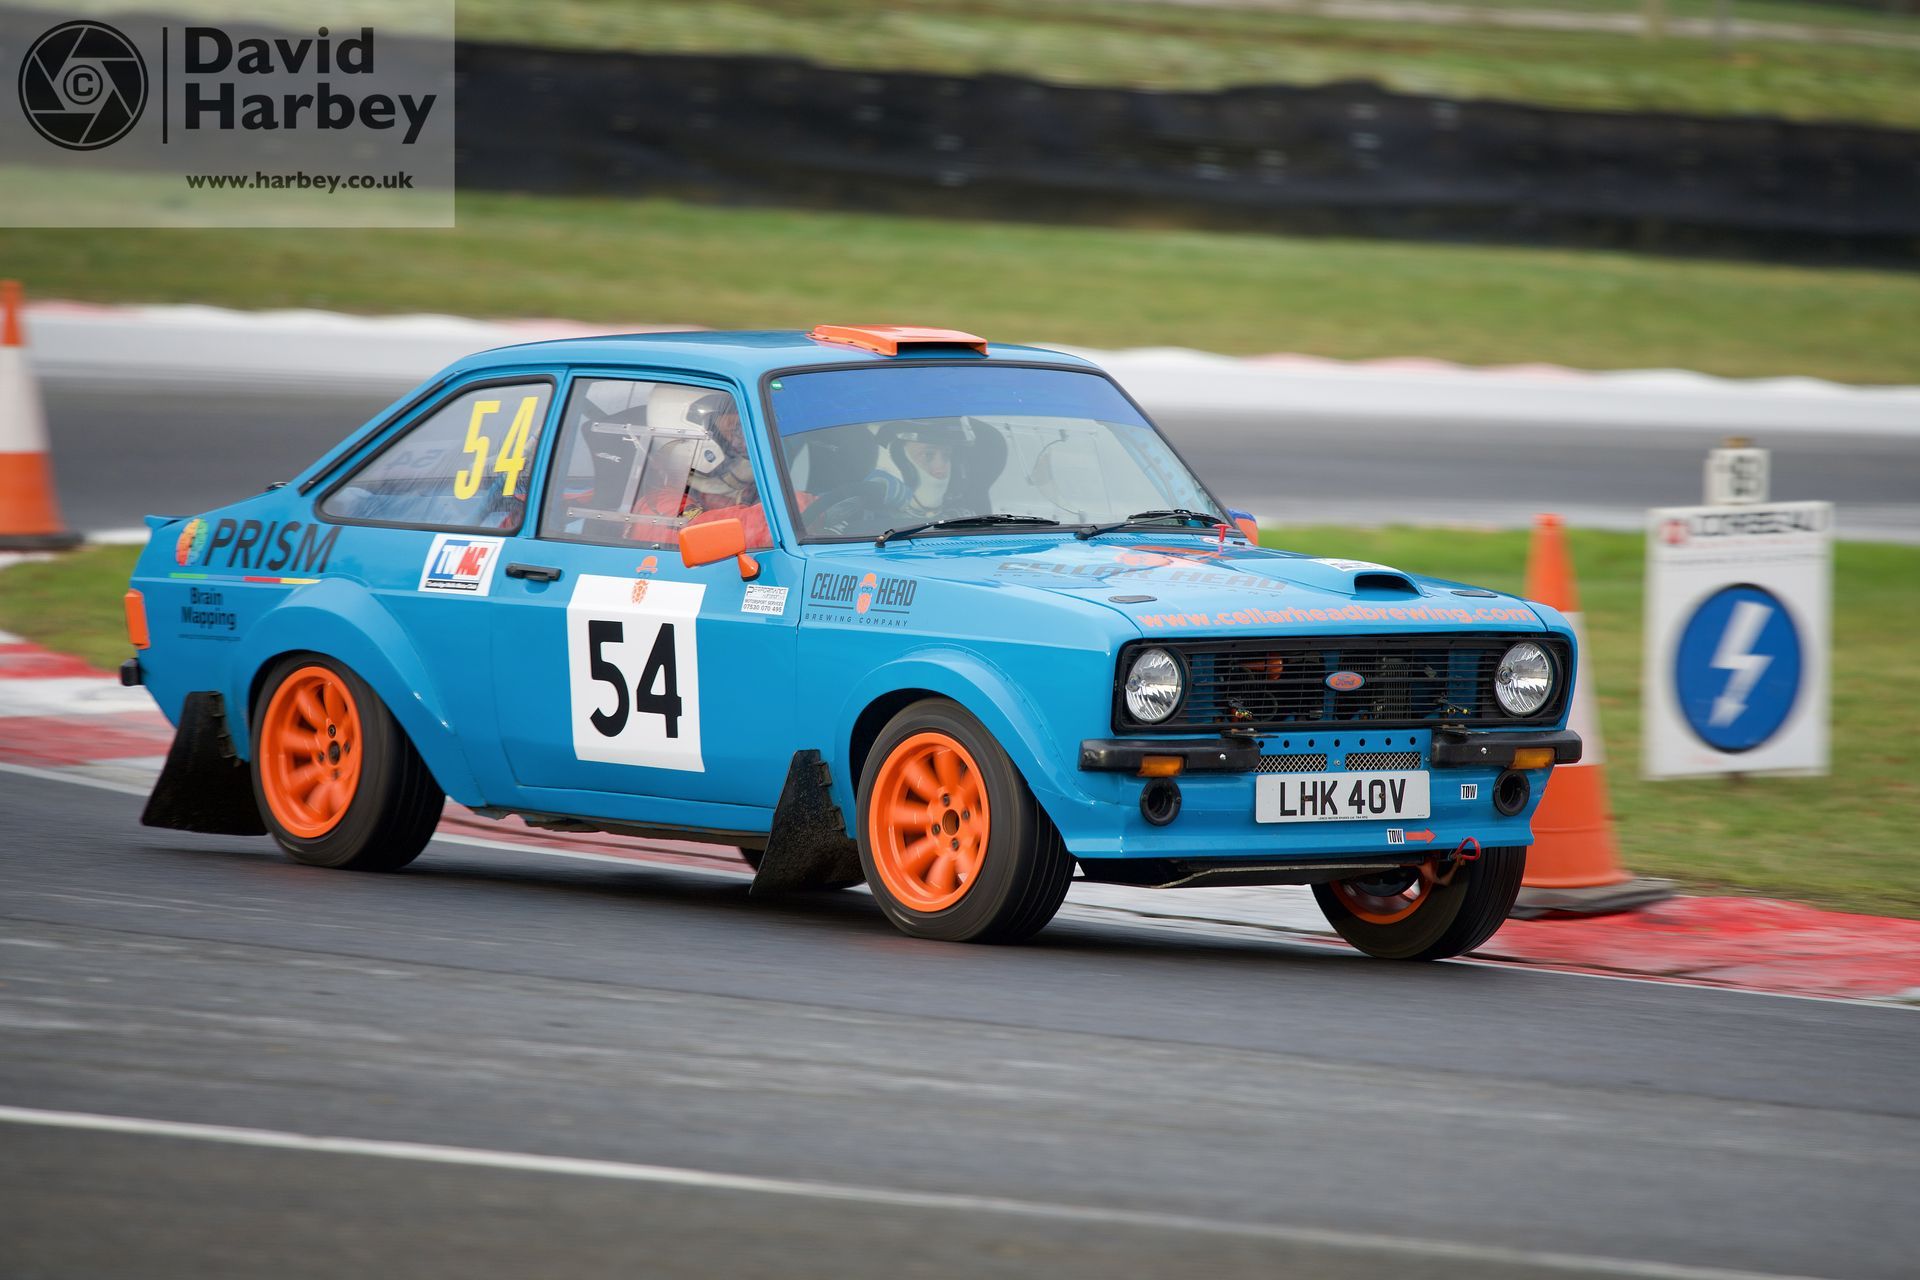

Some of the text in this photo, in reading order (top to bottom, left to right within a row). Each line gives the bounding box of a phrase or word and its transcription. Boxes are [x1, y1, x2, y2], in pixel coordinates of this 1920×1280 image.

[454, 397, 538, 500] 54
[202, 518, 343, 574] PRISM
[811, 573, 917, 606] CELLAR HEAD
[1168, 570, 1288, 590] HEAD
[190, 587, 223, 605] Brain
[181, 607, 237, 630] Mapping
[805, 613, 907, 626] BREWING COMPANY
[1136, 605, 1537, 627] www.cellarheadbrewing.com
[588, 620, 682, 739] 54
[1280, 779, 1406, 816] LHK 40V
[1462, 785, 1477, 799] TOW
[1388, 829, 1404, 843] TOW
